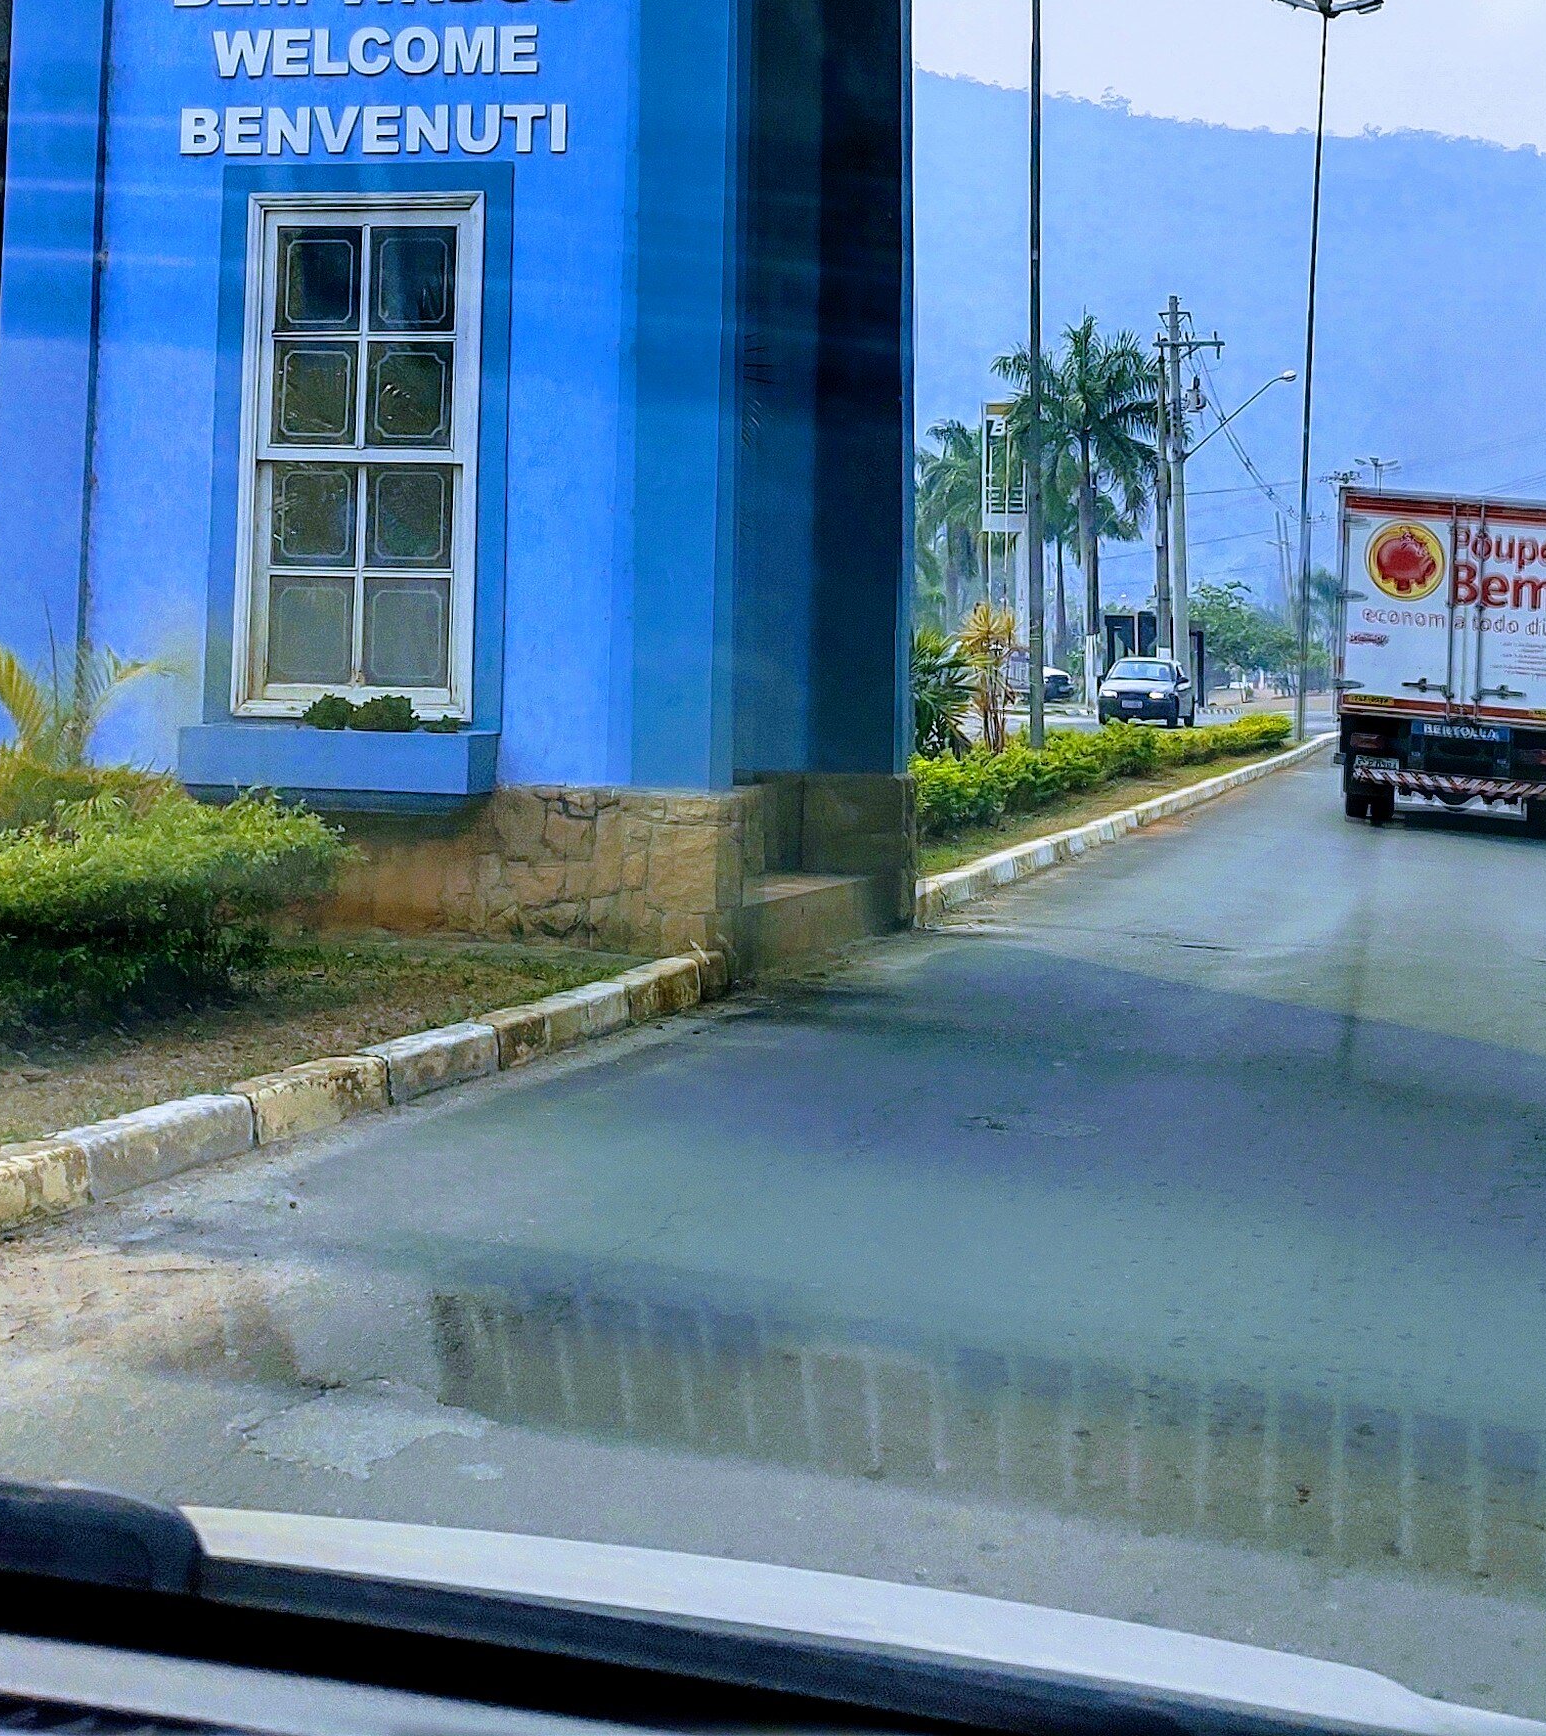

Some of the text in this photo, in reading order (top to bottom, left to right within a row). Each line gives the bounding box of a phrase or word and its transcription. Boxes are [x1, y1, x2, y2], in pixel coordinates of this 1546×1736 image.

[213, 24, 539, 77] WELCOME
[179, 103, 568, 155] BENVENUTI
[1362, 608, 1466, 630] economa
[1472, 614, 1520, 635] todo
